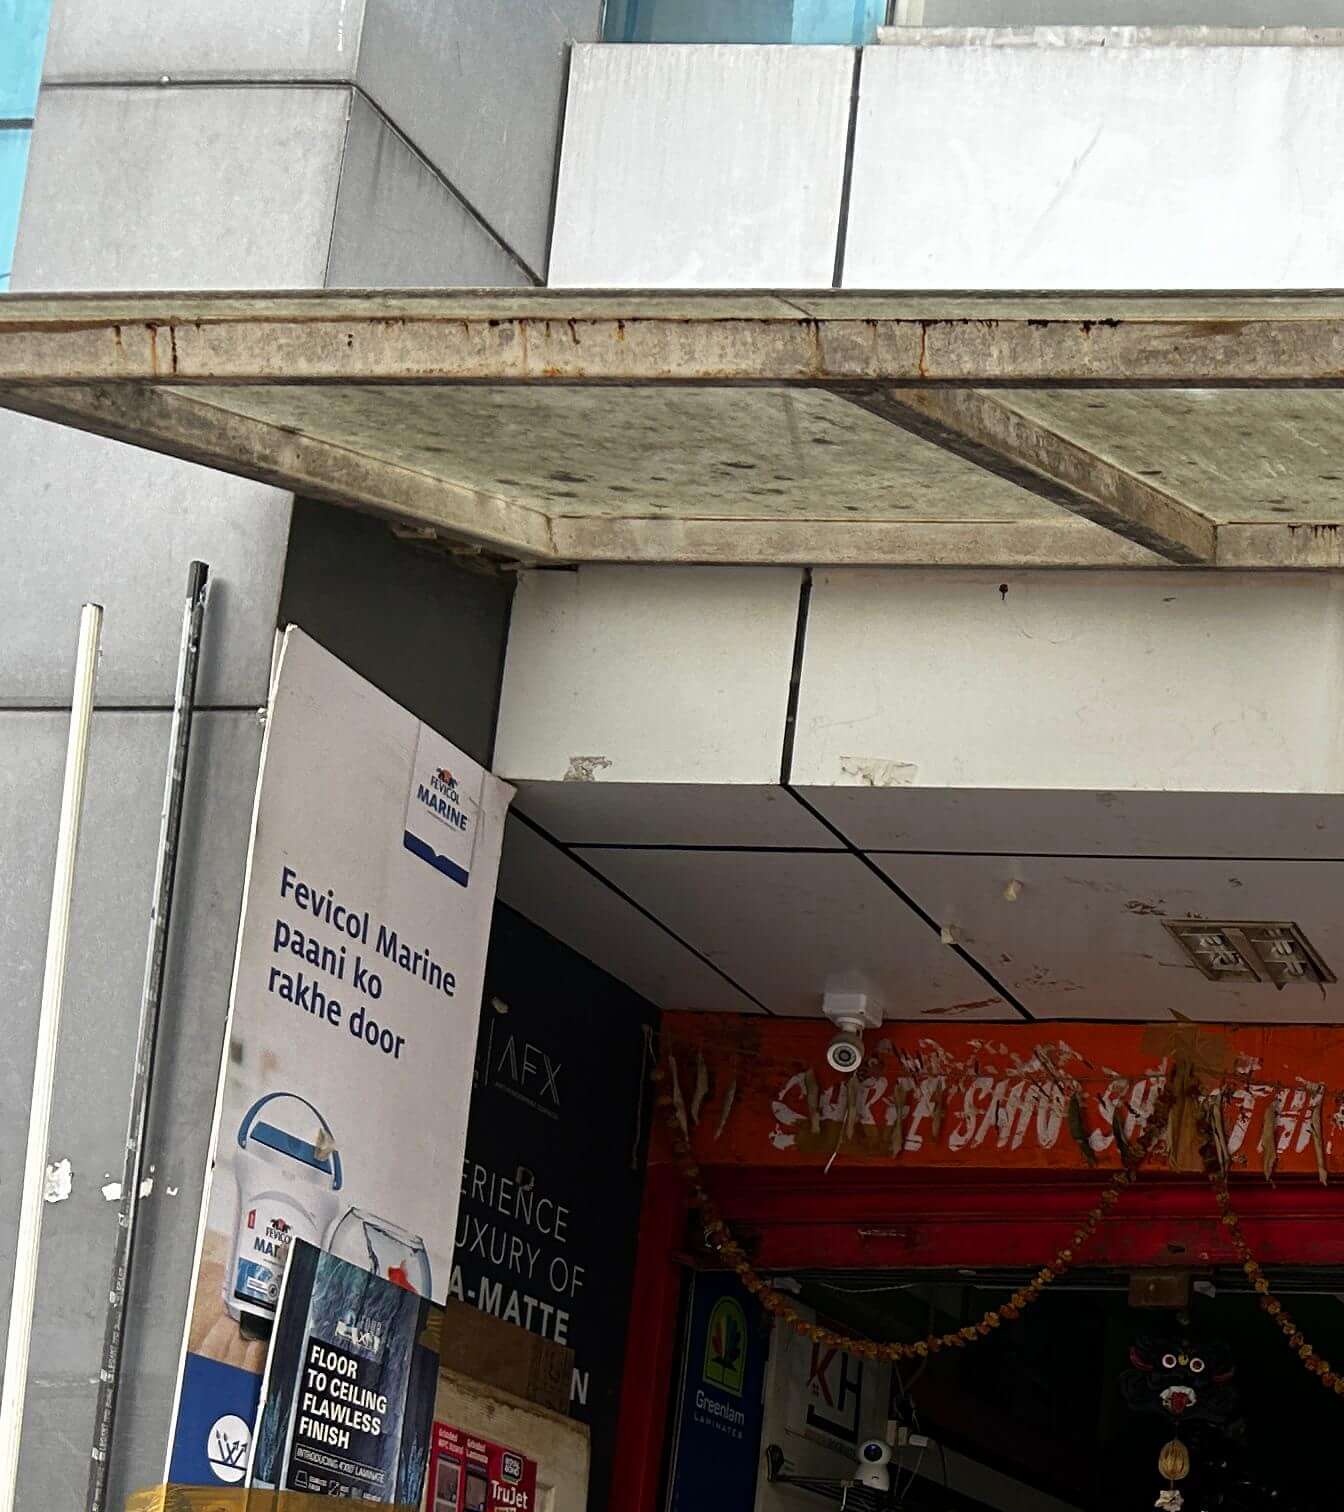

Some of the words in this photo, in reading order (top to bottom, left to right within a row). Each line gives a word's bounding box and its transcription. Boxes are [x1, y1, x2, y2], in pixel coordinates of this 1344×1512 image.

[417, 783, 468, 831] MARINE
[280, 866, 369, 944] Fevicol
[375, 925, 457, 998] Marine
[272, 916, 346, 980] paani
[353, 956, 383, 1000] ko
[268, 965, 342, 1026] rakhe
[349, 1006, 406, 1059] door
[550, 1256, 585, 1298] OF
[310, 1345, 358, 1380] FLOOR
[302, 1392, 381, 1436] FLAWLESS
[307, 1369, 327, 1392] TO
[330, 1379, 388, 1415] CEILING
[695, 1390, 745, 1426] Greenlam
[299, 1416, 350, 1449] FINISH
